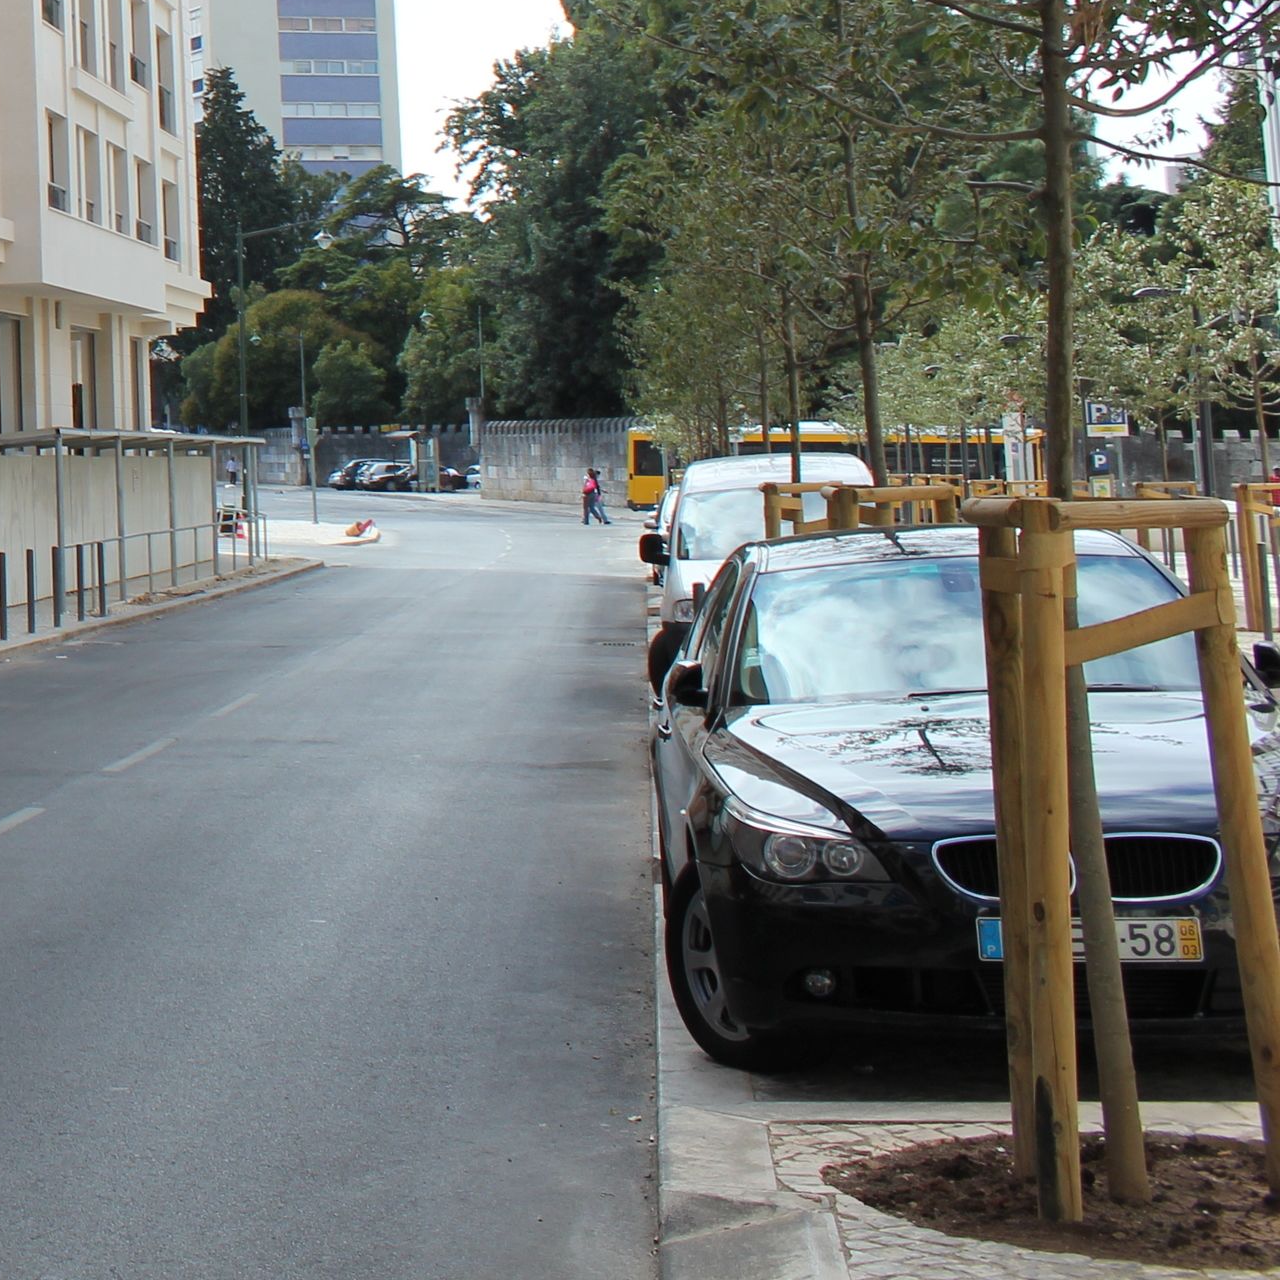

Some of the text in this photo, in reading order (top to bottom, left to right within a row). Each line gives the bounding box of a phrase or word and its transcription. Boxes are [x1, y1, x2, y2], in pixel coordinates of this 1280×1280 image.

[1091, 403, 1108, 424] P
[1094, 454, 1107, 469] P
[1180, 925, 1195, 936] 06
[987, 945, 996, 956] P
[1182, 945, 1197, 956] 03
